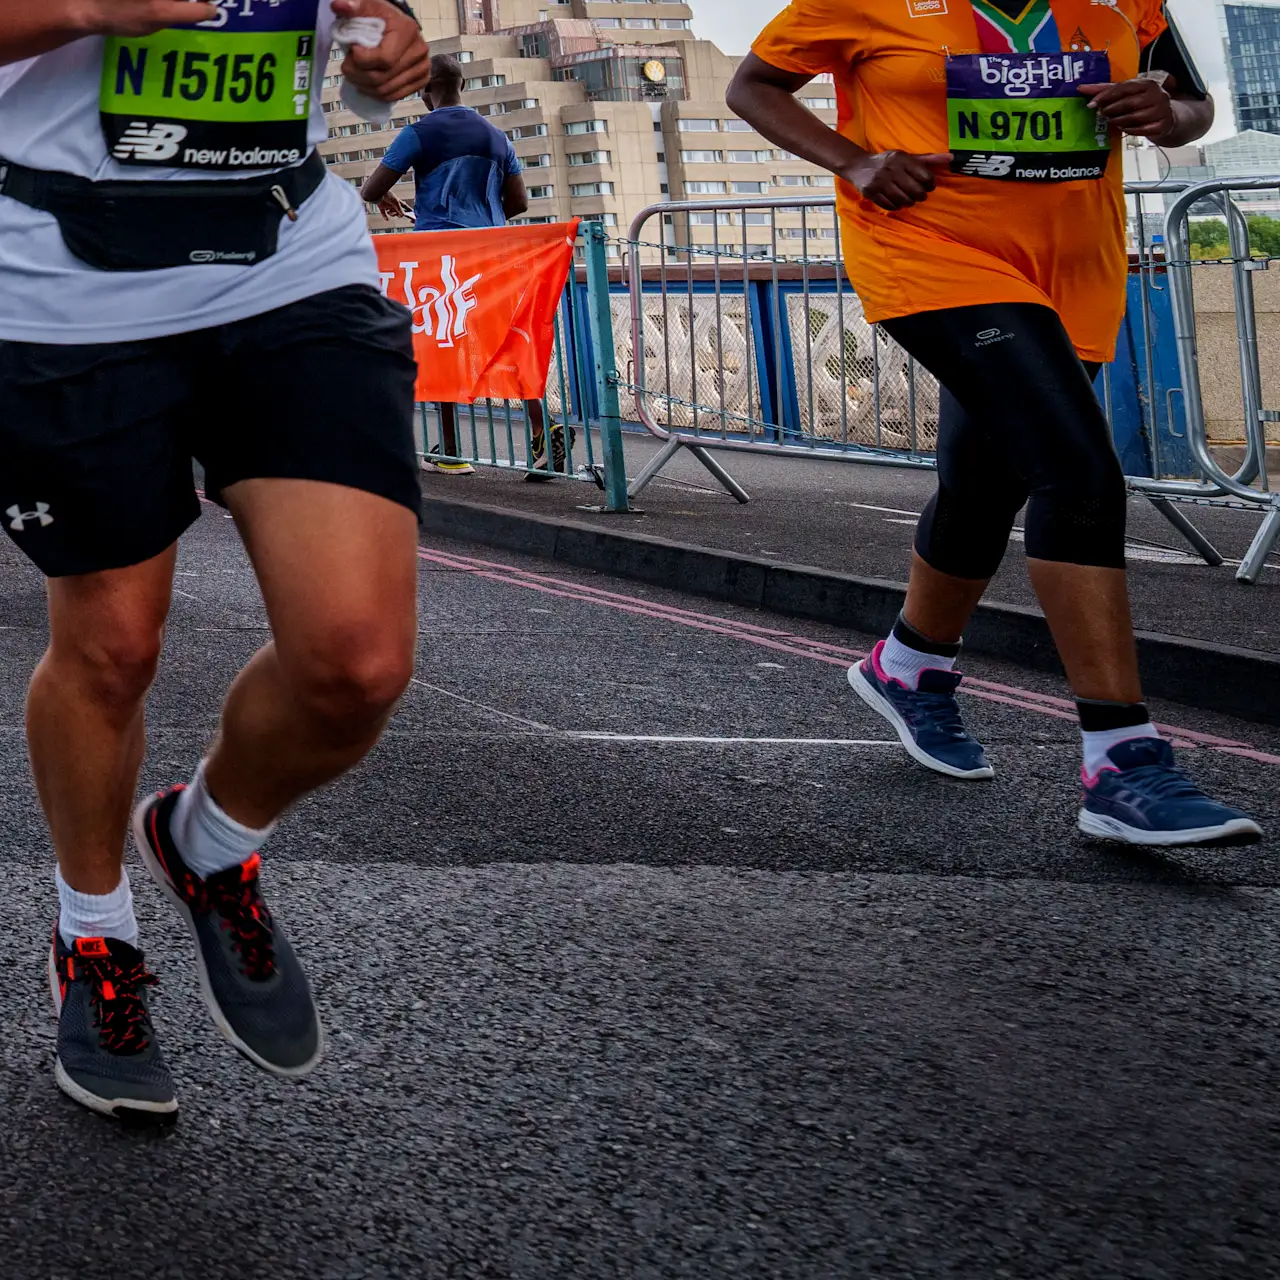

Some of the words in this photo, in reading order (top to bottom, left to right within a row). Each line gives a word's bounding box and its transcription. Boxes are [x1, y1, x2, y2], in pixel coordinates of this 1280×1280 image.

[115, 45, 148, 96] N
[162, 50, 277, 103] 15156
[112, 121, 188, 160] NB
[184, 148, 228, 164] new
[228, 147, 300, 166] balance
[958, 112, 979, 139] N
[990, 110, 1062, 141] 9701
[962, 154, 1016, 176] NB
[1016, 168, 1046, 178] new
[1050, 167, 1100, 178] balance
[380, 255, 482, 348] Half
[82, 941, 101, 952] NIKE
